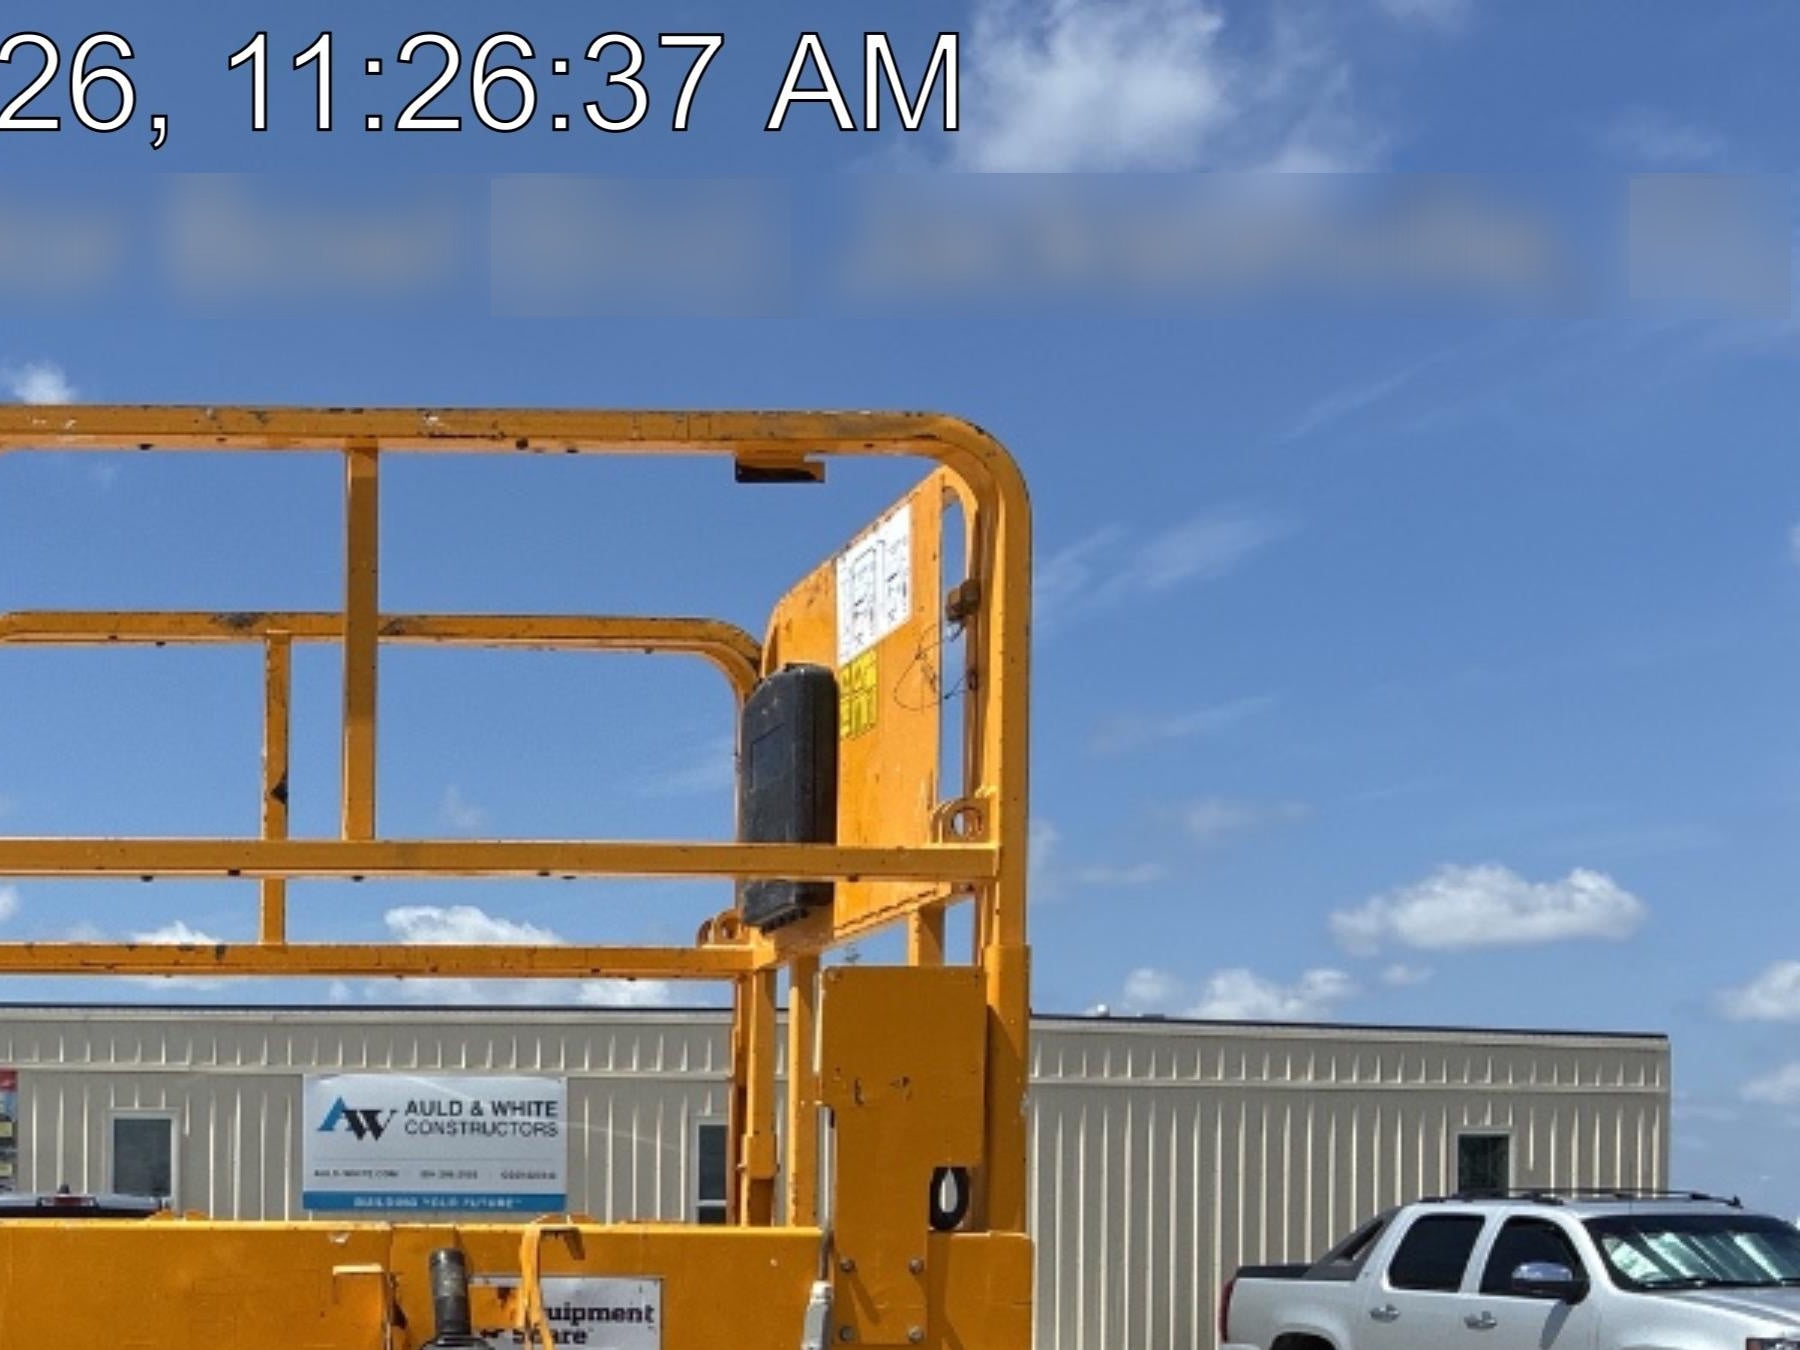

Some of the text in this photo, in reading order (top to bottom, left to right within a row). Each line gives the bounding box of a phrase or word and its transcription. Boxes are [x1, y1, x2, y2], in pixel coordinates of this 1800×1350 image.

[404, 1100, 559, 1118] AULD & WHITE
[404, 1119, 559, 1137] CONSTRUCTORS
[543, 1301, 655, 1328] uipment
